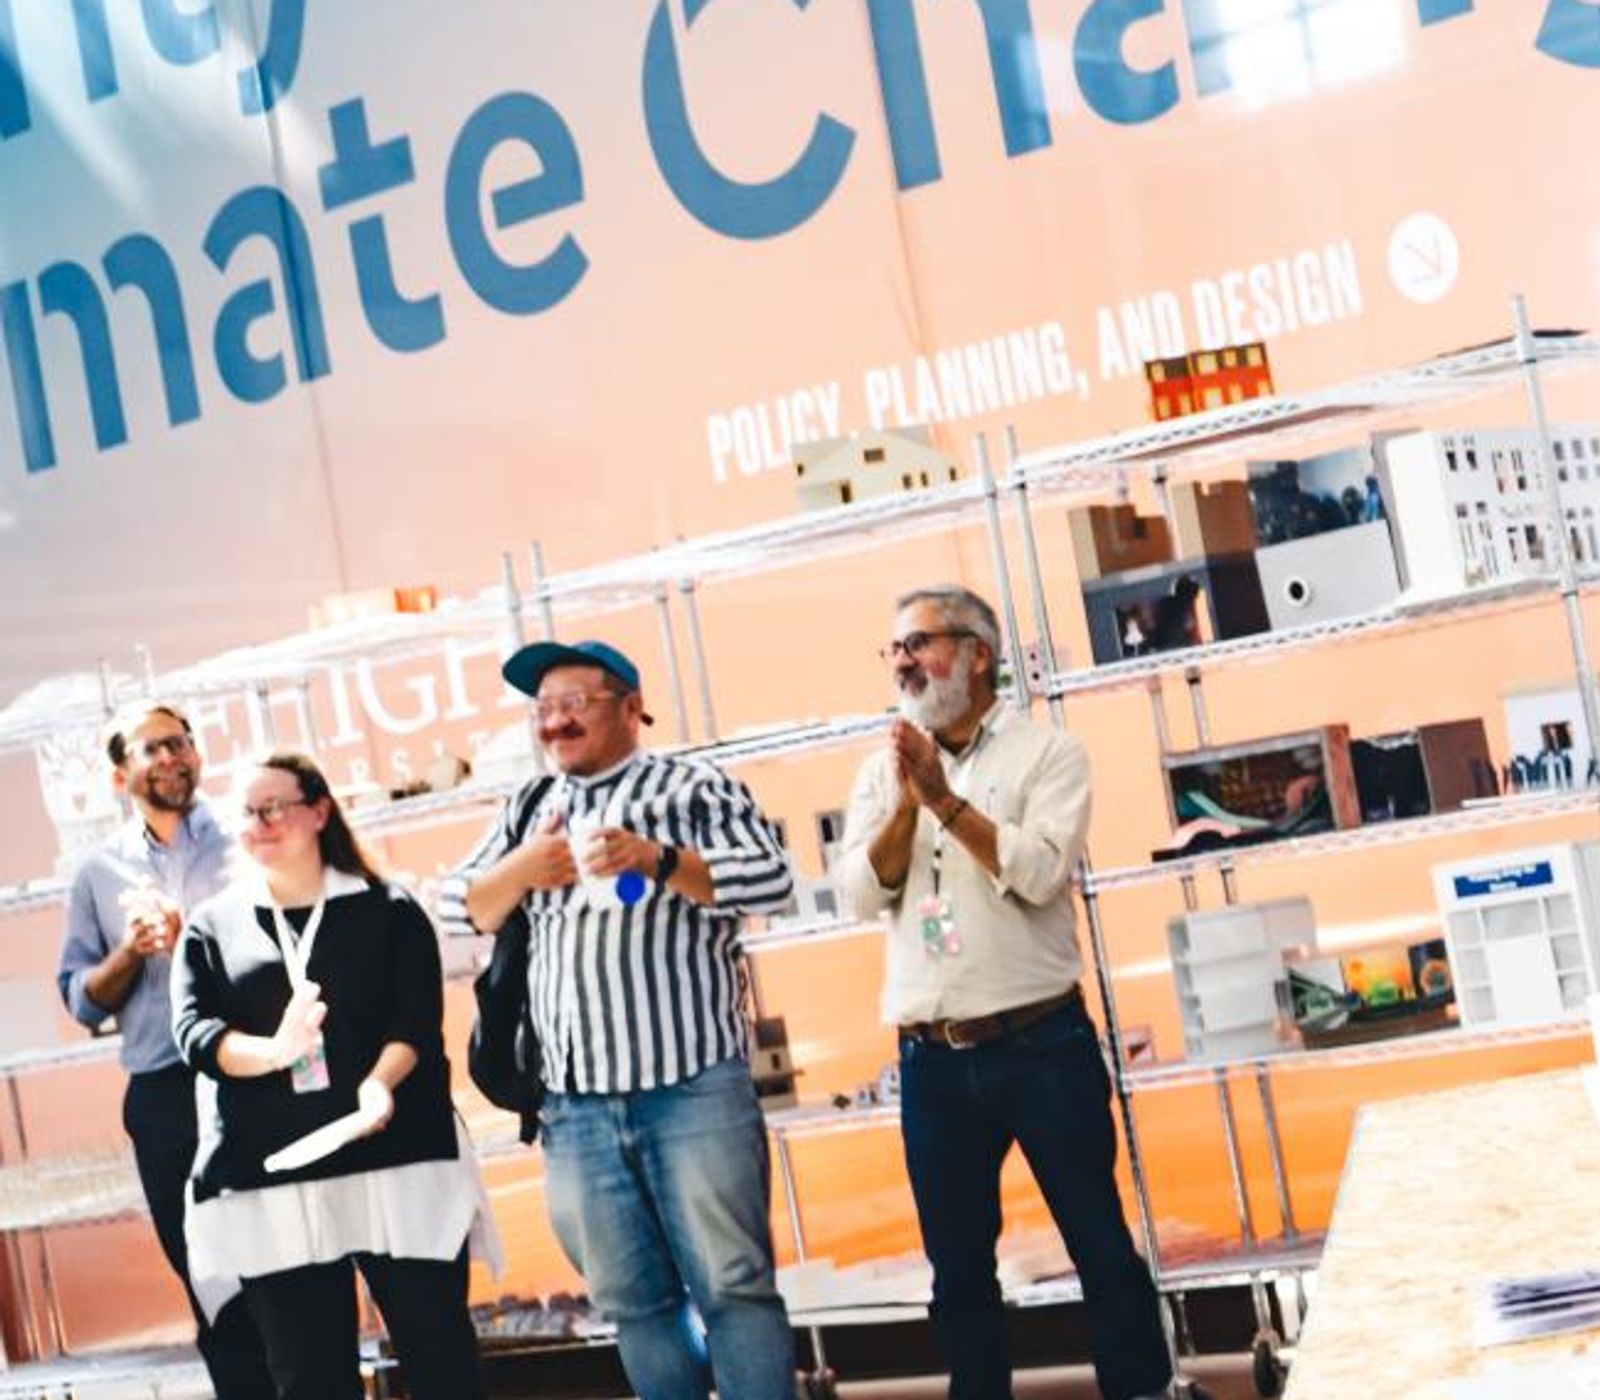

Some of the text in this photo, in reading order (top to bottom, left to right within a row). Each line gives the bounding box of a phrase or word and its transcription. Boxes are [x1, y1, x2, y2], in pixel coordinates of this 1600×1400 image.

[865, 321, 1091, 434] PLANNING,
[1095, 290, 1186, 381] AND
[1193, 240, 1364, 349] DESIGN
